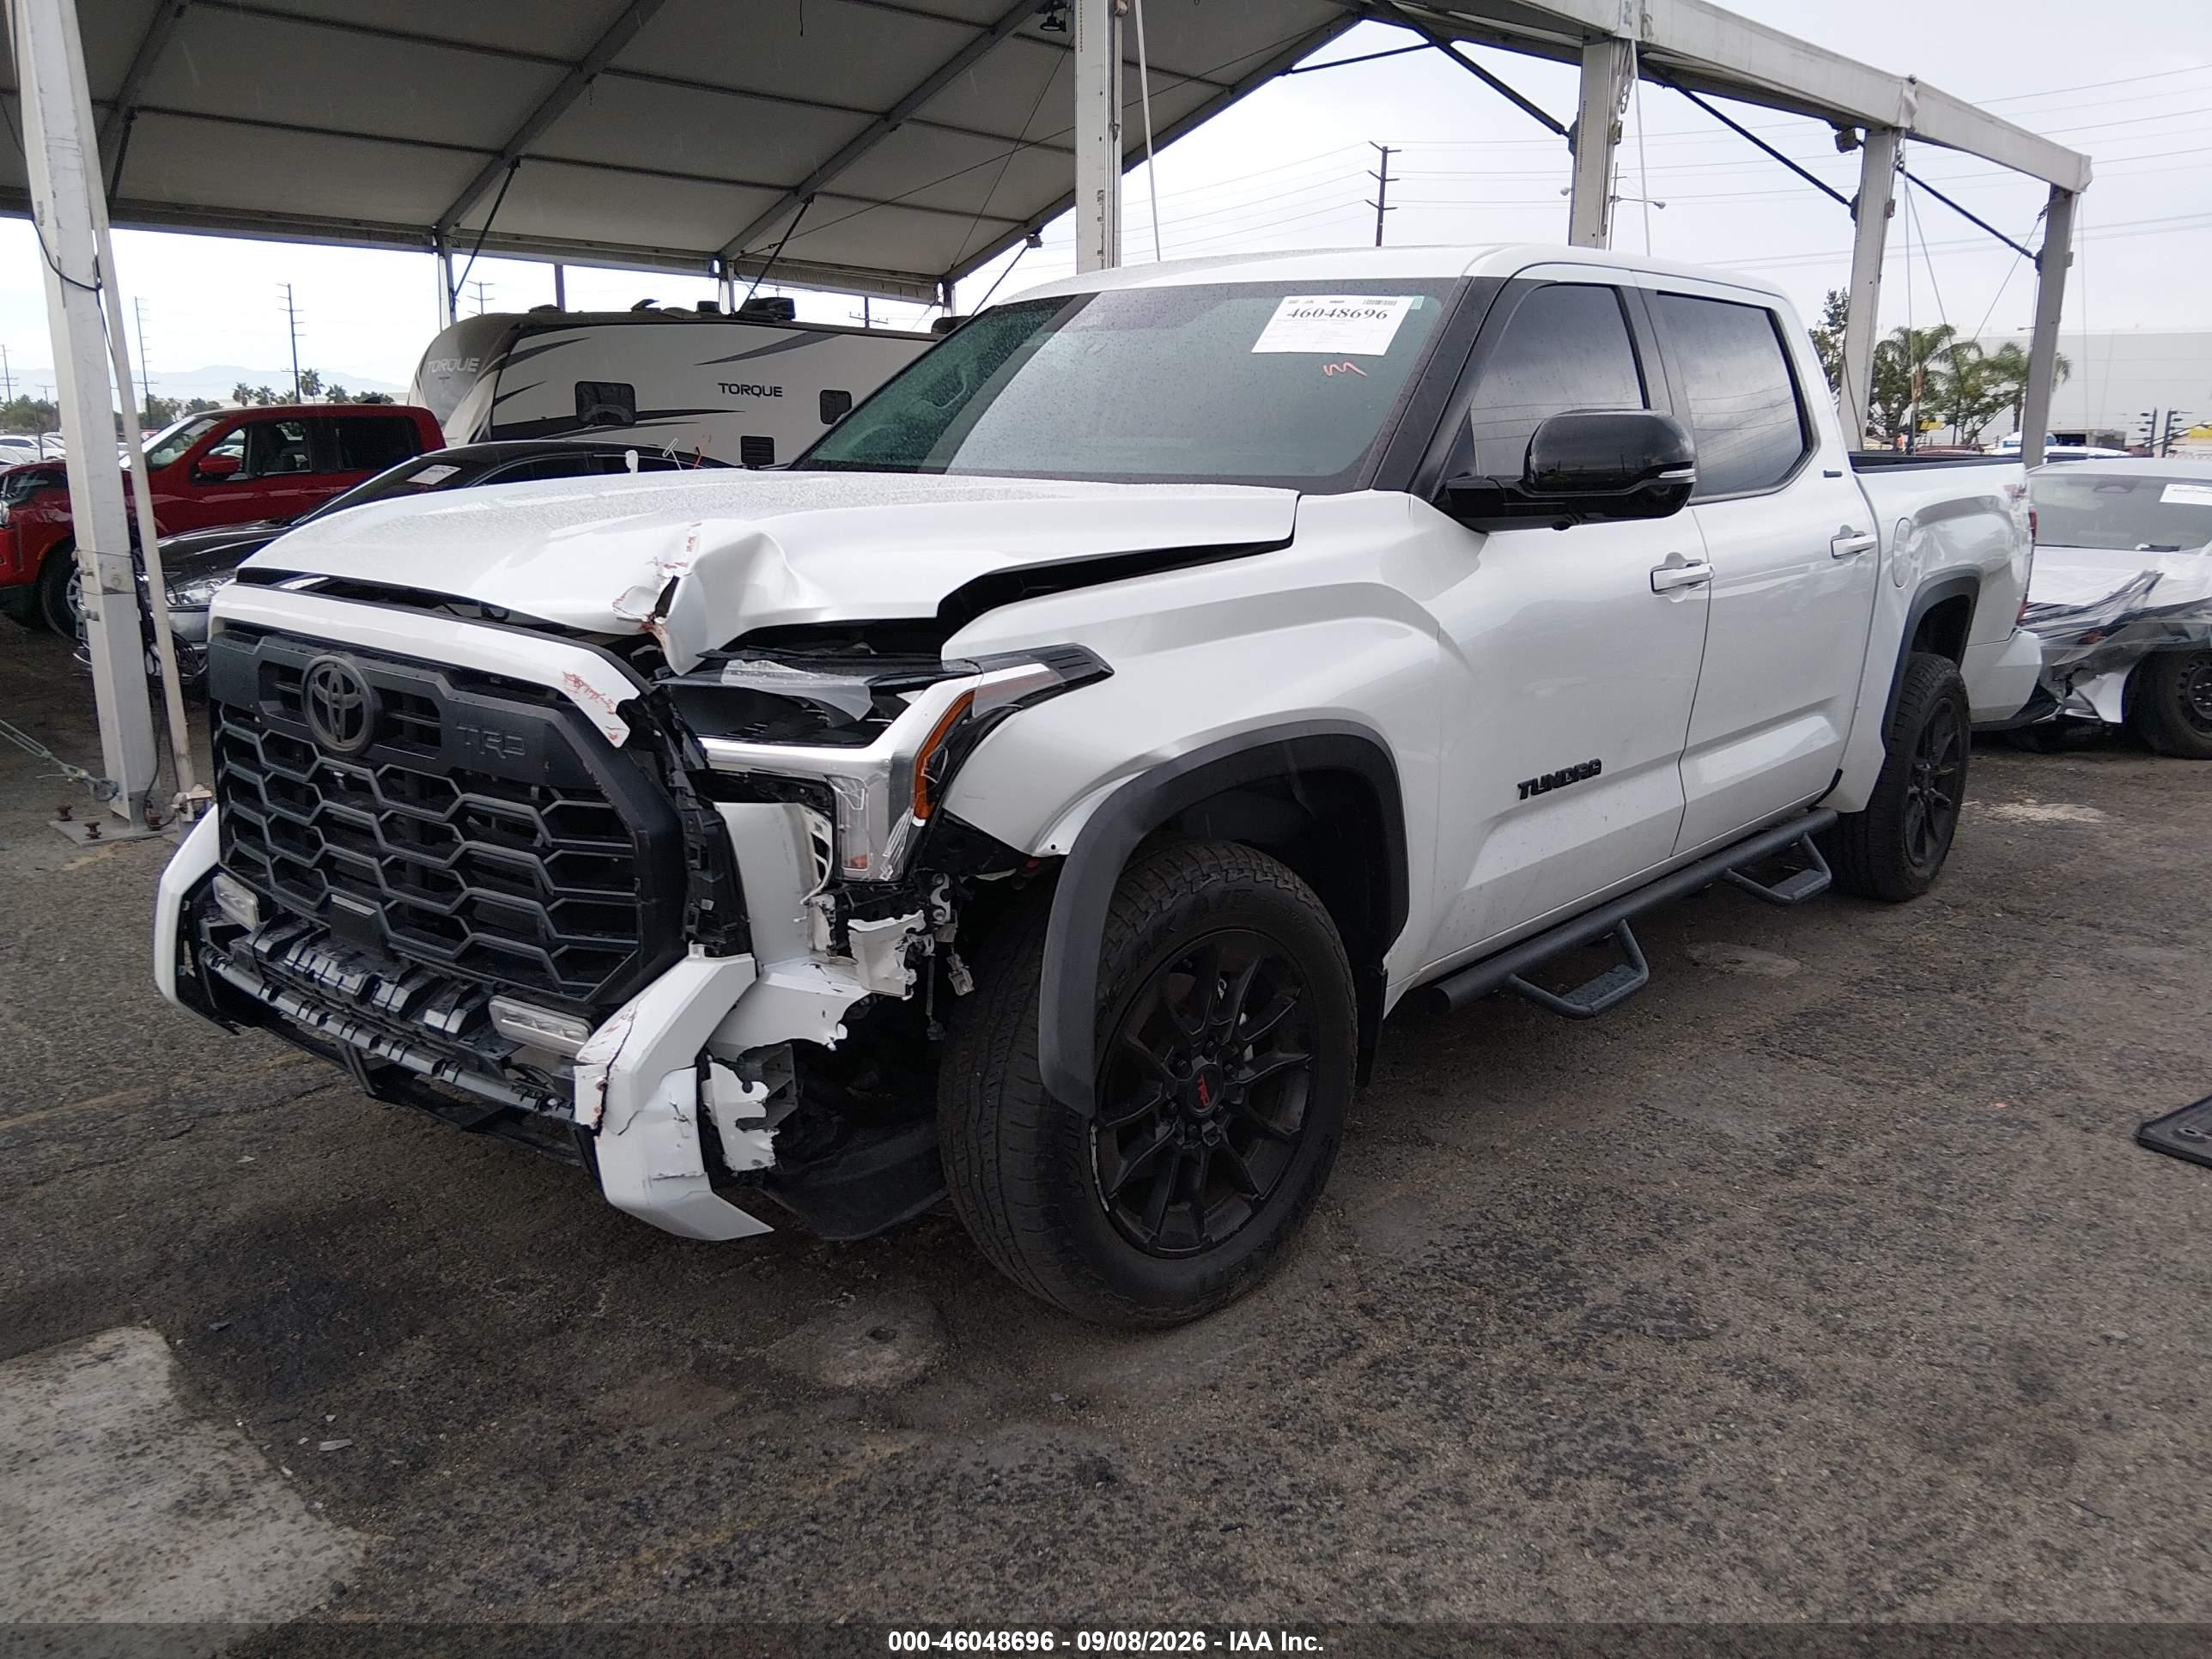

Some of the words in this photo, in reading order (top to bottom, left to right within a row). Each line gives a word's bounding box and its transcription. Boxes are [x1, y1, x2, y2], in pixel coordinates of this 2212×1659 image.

[1286, 307, 1389, 320] 46048696
[428, 357, 481, 374] TORQUE
[717, 382, 783, 398] TORQUE
[456, 726, 527, 759] TRD
[1516, 757, 1602, 800] TUNDRA
